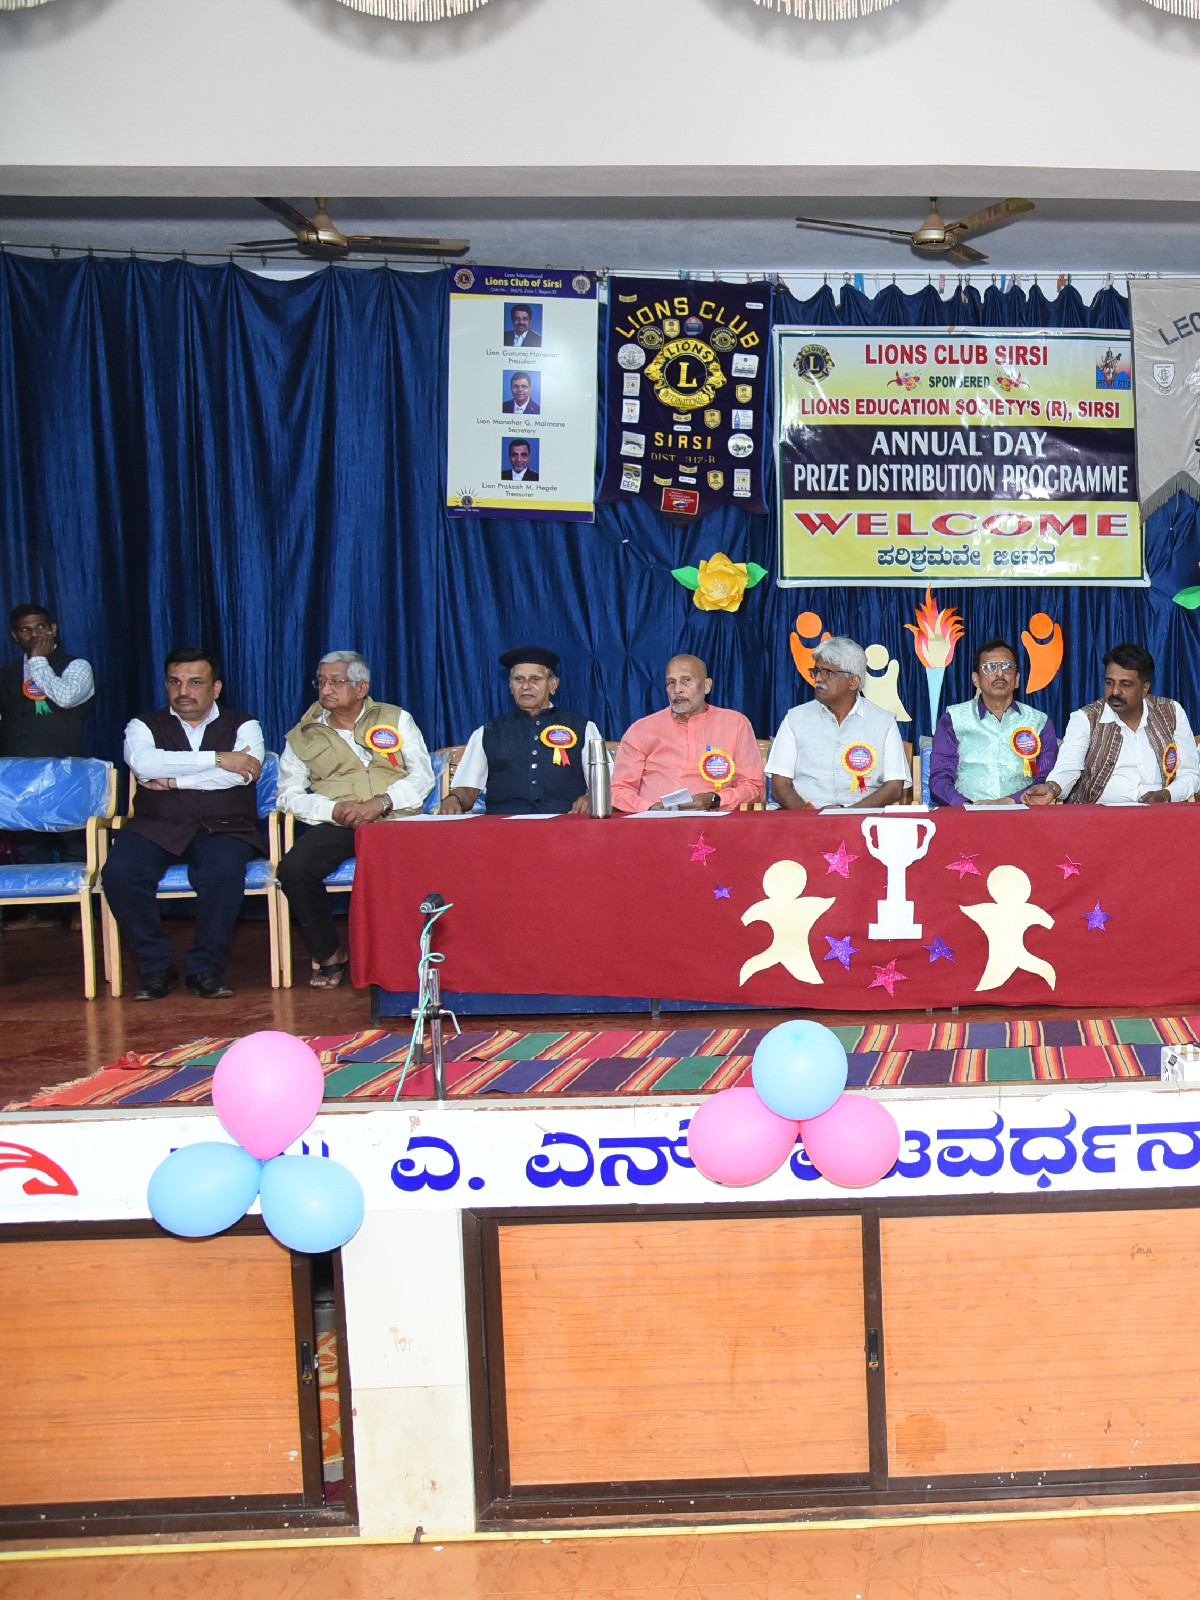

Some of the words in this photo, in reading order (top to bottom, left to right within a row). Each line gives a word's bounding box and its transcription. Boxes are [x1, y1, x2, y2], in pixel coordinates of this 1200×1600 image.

[485, 276, 509, 287] Lions
[510, 277, 530, 288] Club
[531, 278, 542, 288] of
[543, 278, 562, 289] Sirsi
[615, 296, 690, 339] LIONS
[699, 300, 760, 349] CLUB
[667, 341, 712, 360] LIONS
[865, 344, 928, 365] LIONS
[934, 344, 988, 365] CLUB
[995, 344, 1048, 366] SIRSI
[808, 355, 820, 371] L
[678, 361, 698, 388] L
[801, 398, 850, 415] LIONS
[855, 398, 950, 415] EDUCATION
[1046, 400, 1073, 421] (R),
[1077, 401, 1120, 418] SIRSI
[508, 427, 536, 435] Secretary
[654, 431, 712, 450] SIRSI
[871, 431, 982, 456] ANNUAL
[994, 431, 1048, 457] DAY
[651, 452, 677, 462] DIST
[794, 463, 850, 492] PRIZE
[857, 463, 995, 492] DISTRIBUTION
[1002, 464, 1129, 493] PROGRAMME
[793, 512, 1128, 536] WELCOME
